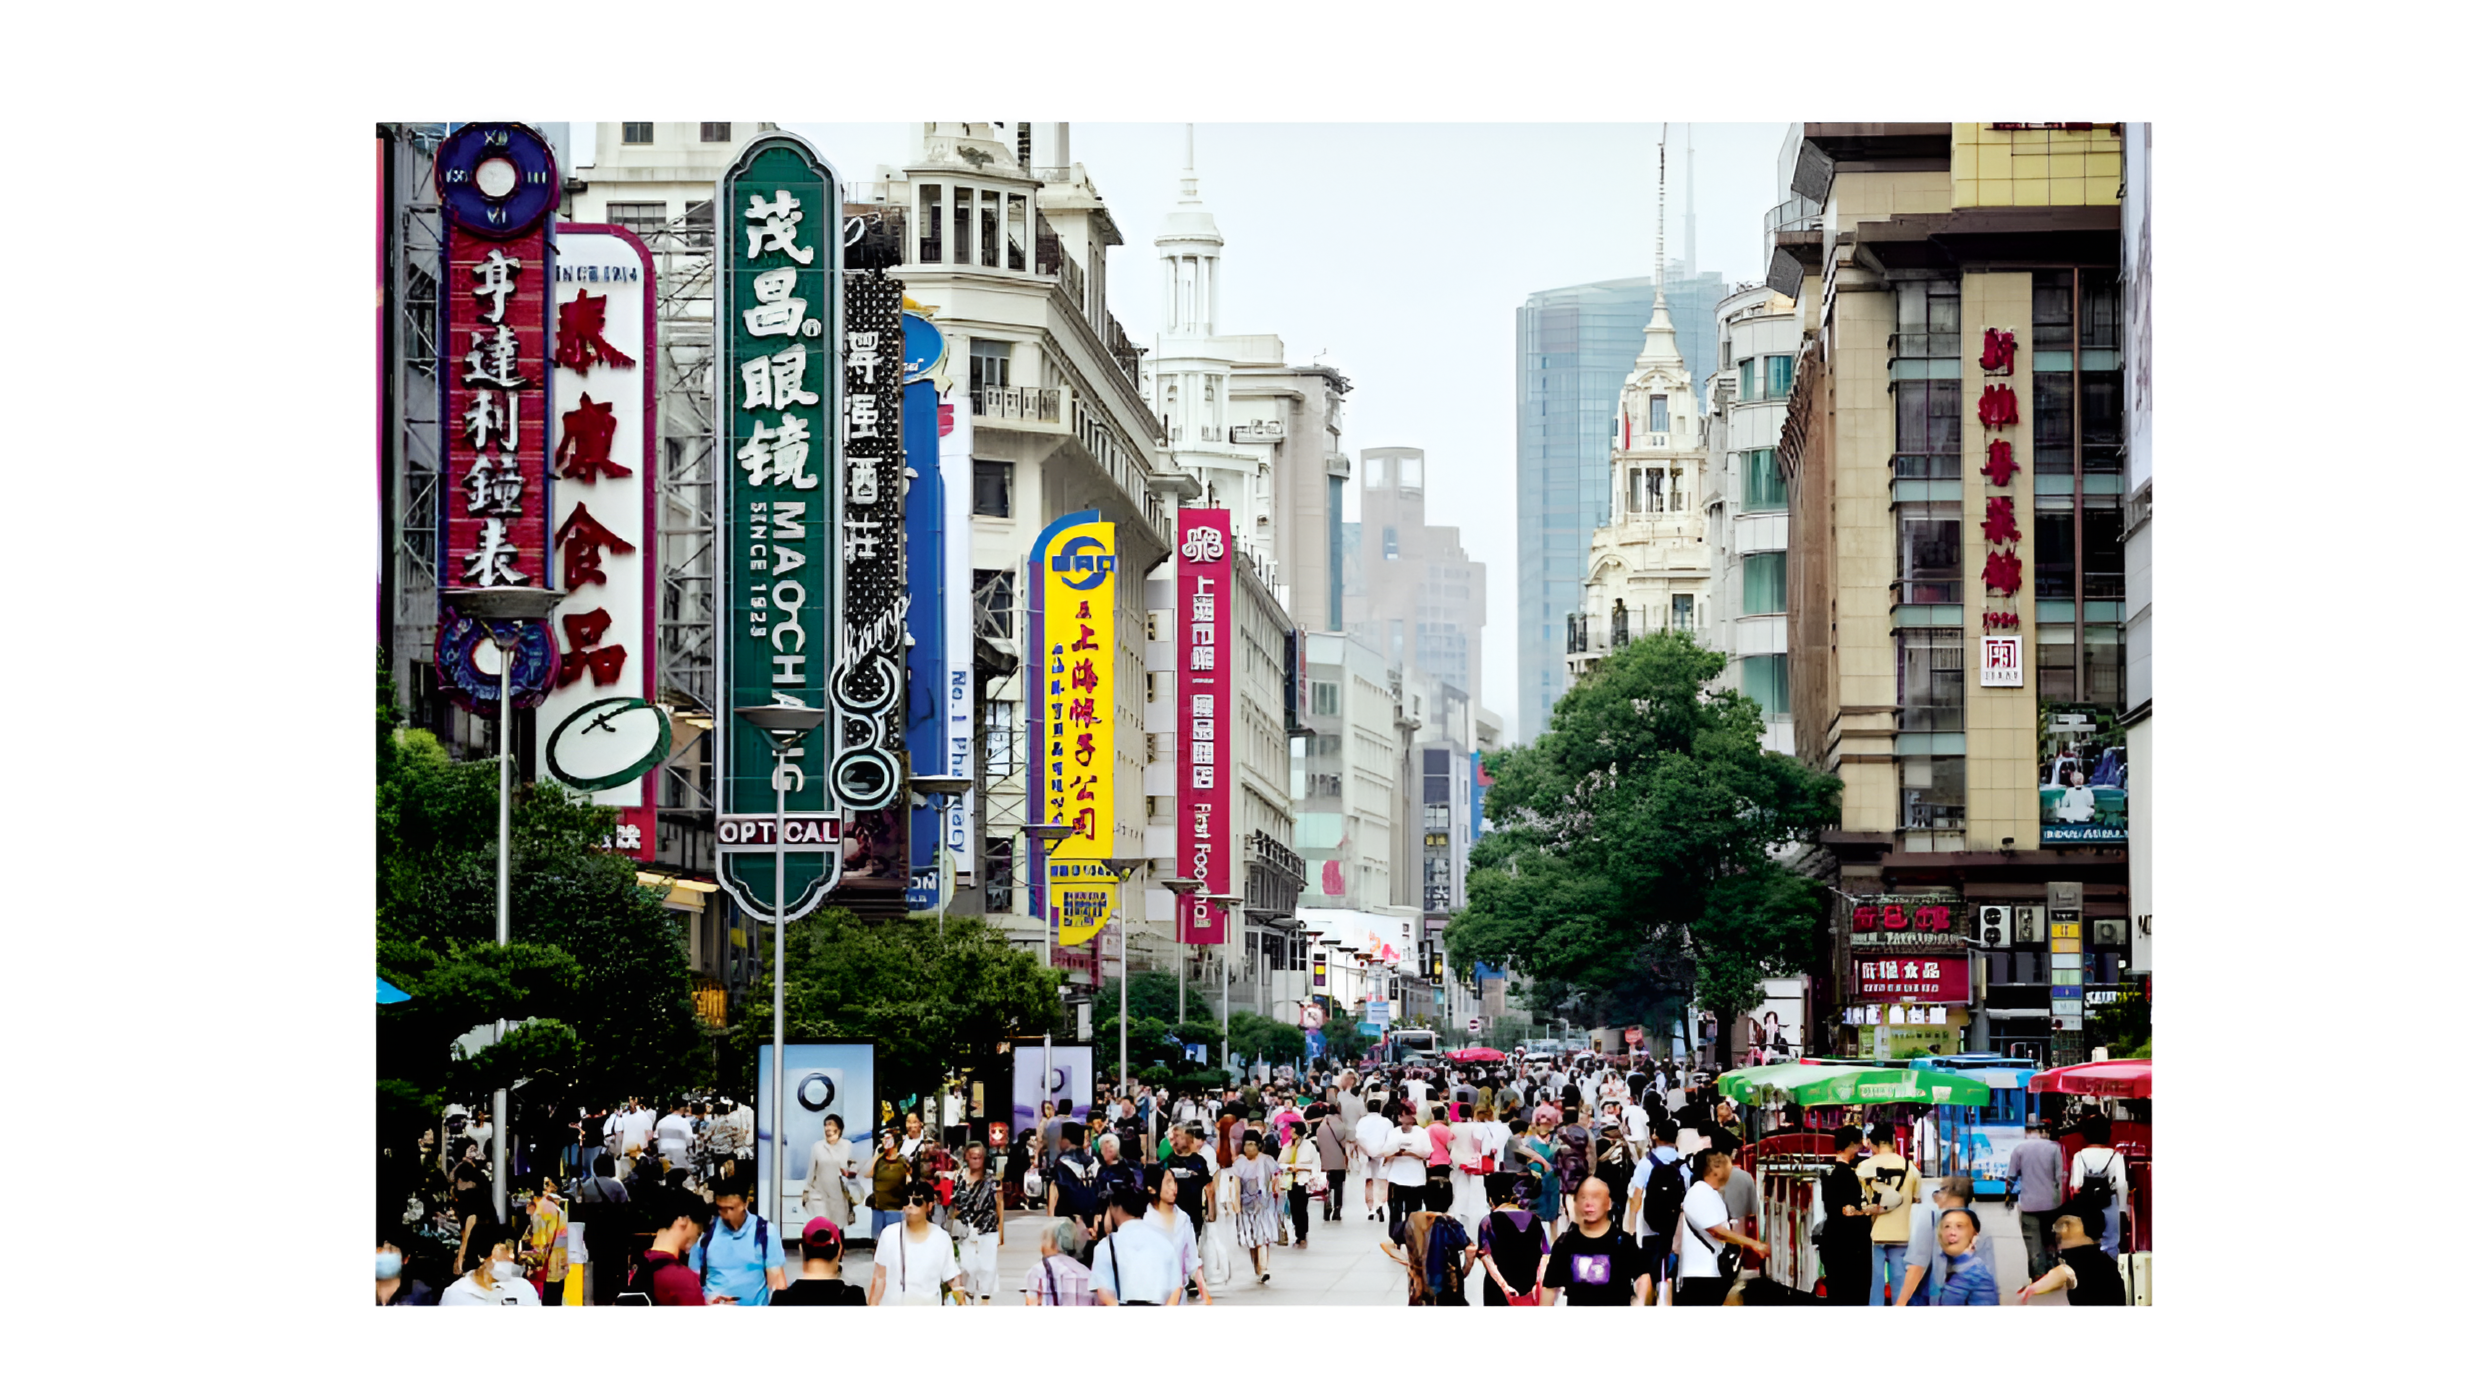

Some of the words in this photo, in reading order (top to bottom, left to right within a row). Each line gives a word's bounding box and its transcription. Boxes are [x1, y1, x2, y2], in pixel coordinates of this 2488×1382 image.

[737, 190, 820, 489] 茂昌眼镜
[555, 288, 636, 688] 泰康食品
[750, 502, 767, 570] SINCE
[772, 501, 805, 792] MAOCHG
[719, 821, 839, 843] OPTCAL
[948, 737, 968, 852] Phaacy
